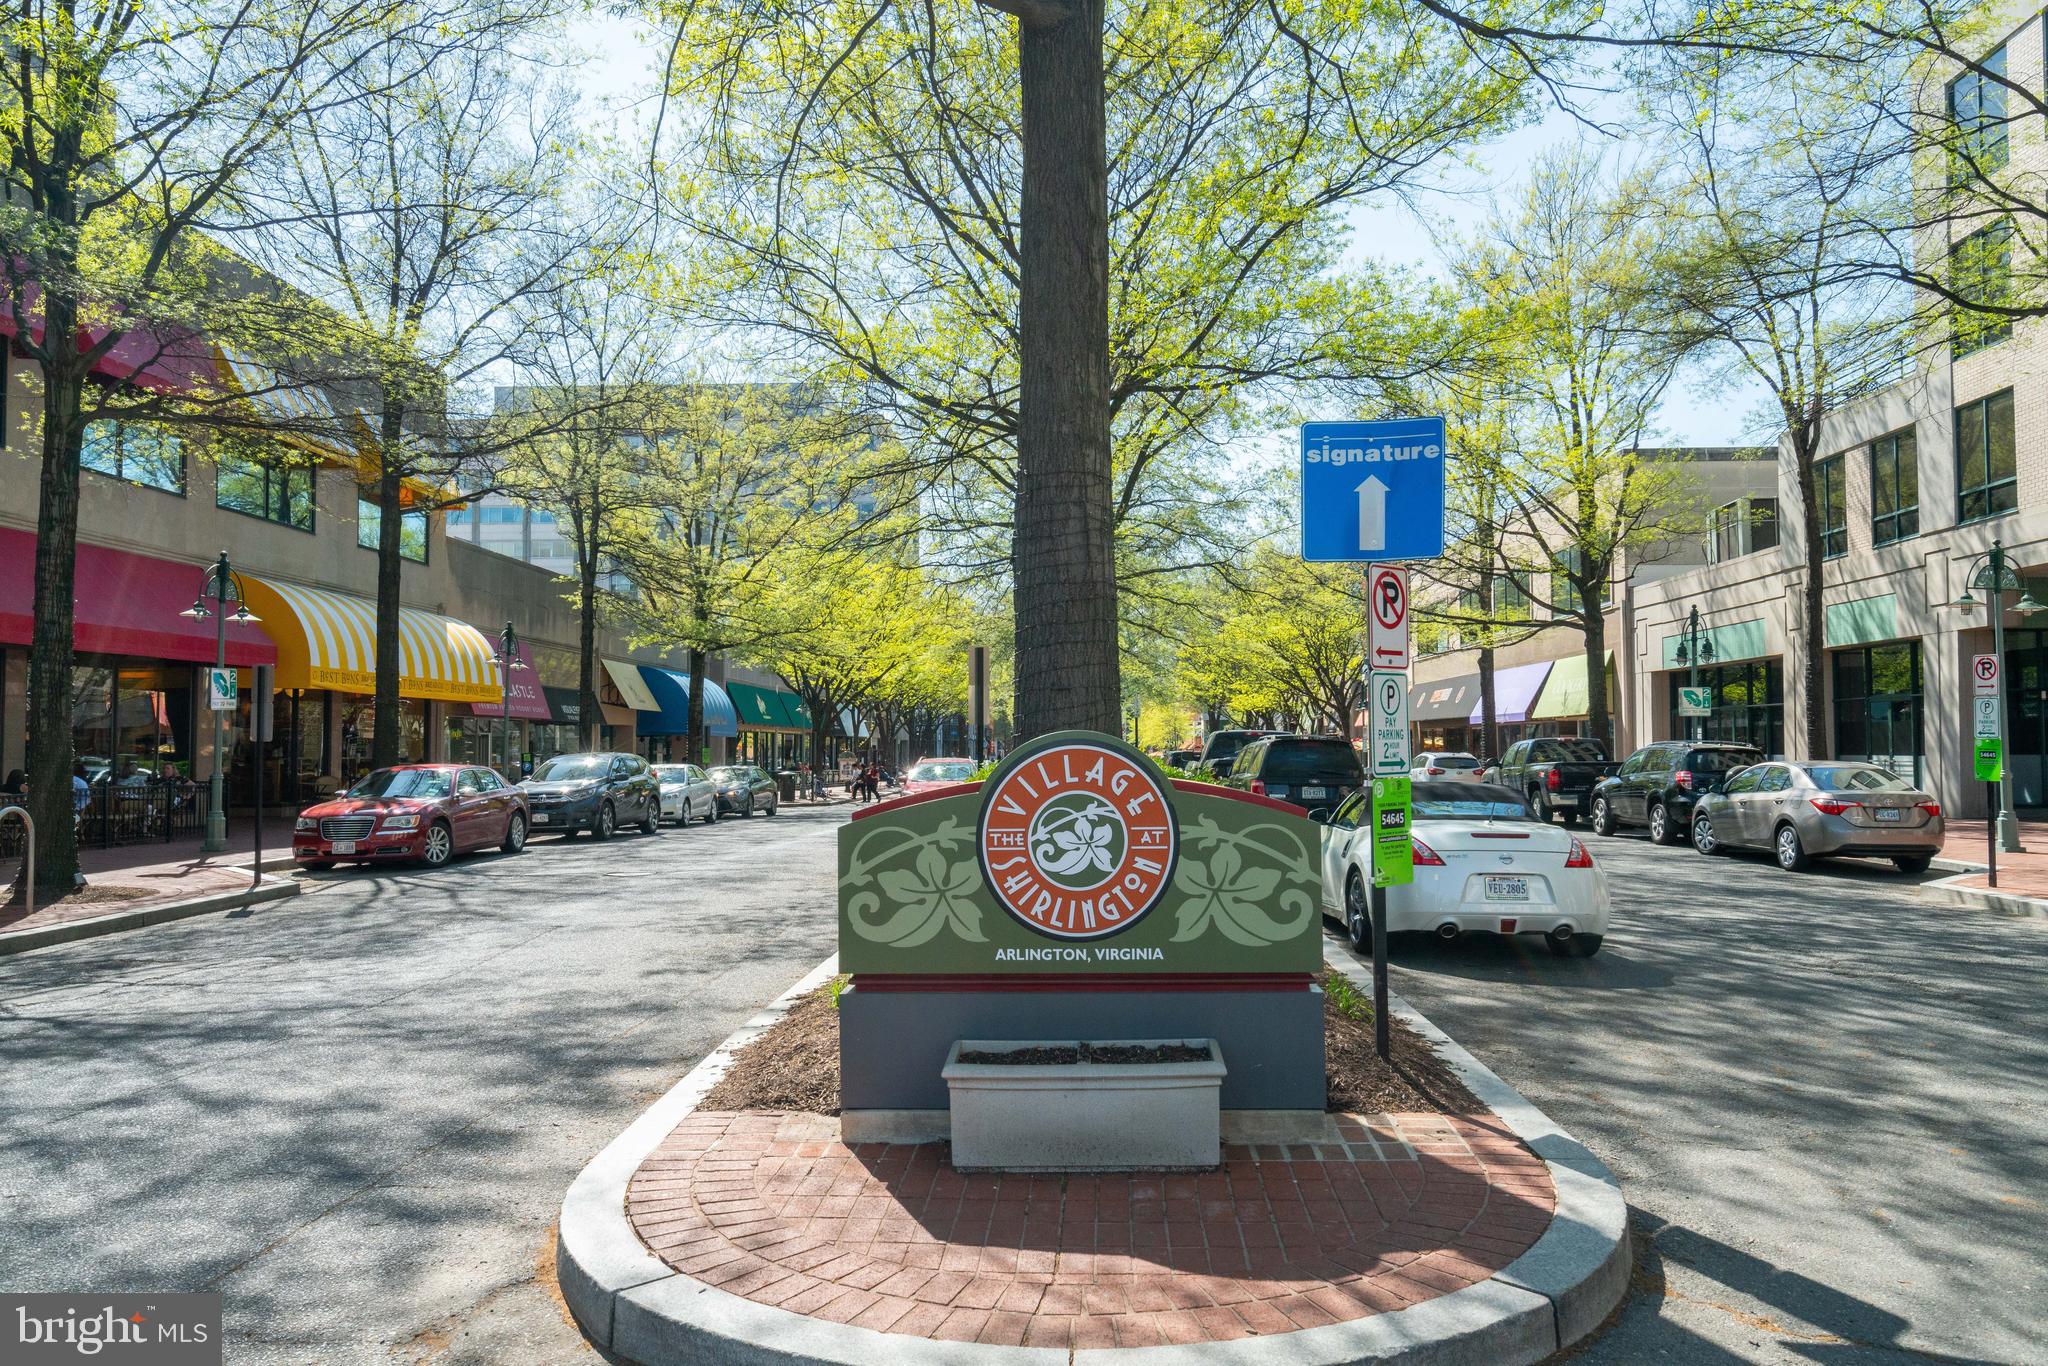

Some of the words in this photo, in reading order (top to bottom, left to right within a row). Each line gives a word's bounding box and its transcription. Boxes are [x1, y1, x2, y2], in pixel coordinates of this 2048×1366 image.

[1306, 444, 1440, 466] signature
[1383, 581, 1399, 618] P
[230, 672, 236, 682] 2
[1387, 685, 1395, 709] P
[1703, 688, 1710, 697] 2
[1984, 702, 1990, 712] P
[1385, 717, 1396, 728] PAY
[1378, 729, 1404, 740] PARKING
[1384, 742, 1389, 759] 2
[997, 754, 1155, 817] VILLAGE
[1382, 812, 1404, 825] 54645
[990, 833, 1024, 846] THE
[1140, 831, 1163, 844] AT
[991, 856, 1162, 929] SHIRLINGTON
[1488, 883, 1526, 894] VEU-2805
[995, 948, 1091, 963] ARLINGTON,
[1095, 947, 1164, 961] VIRGINIA
